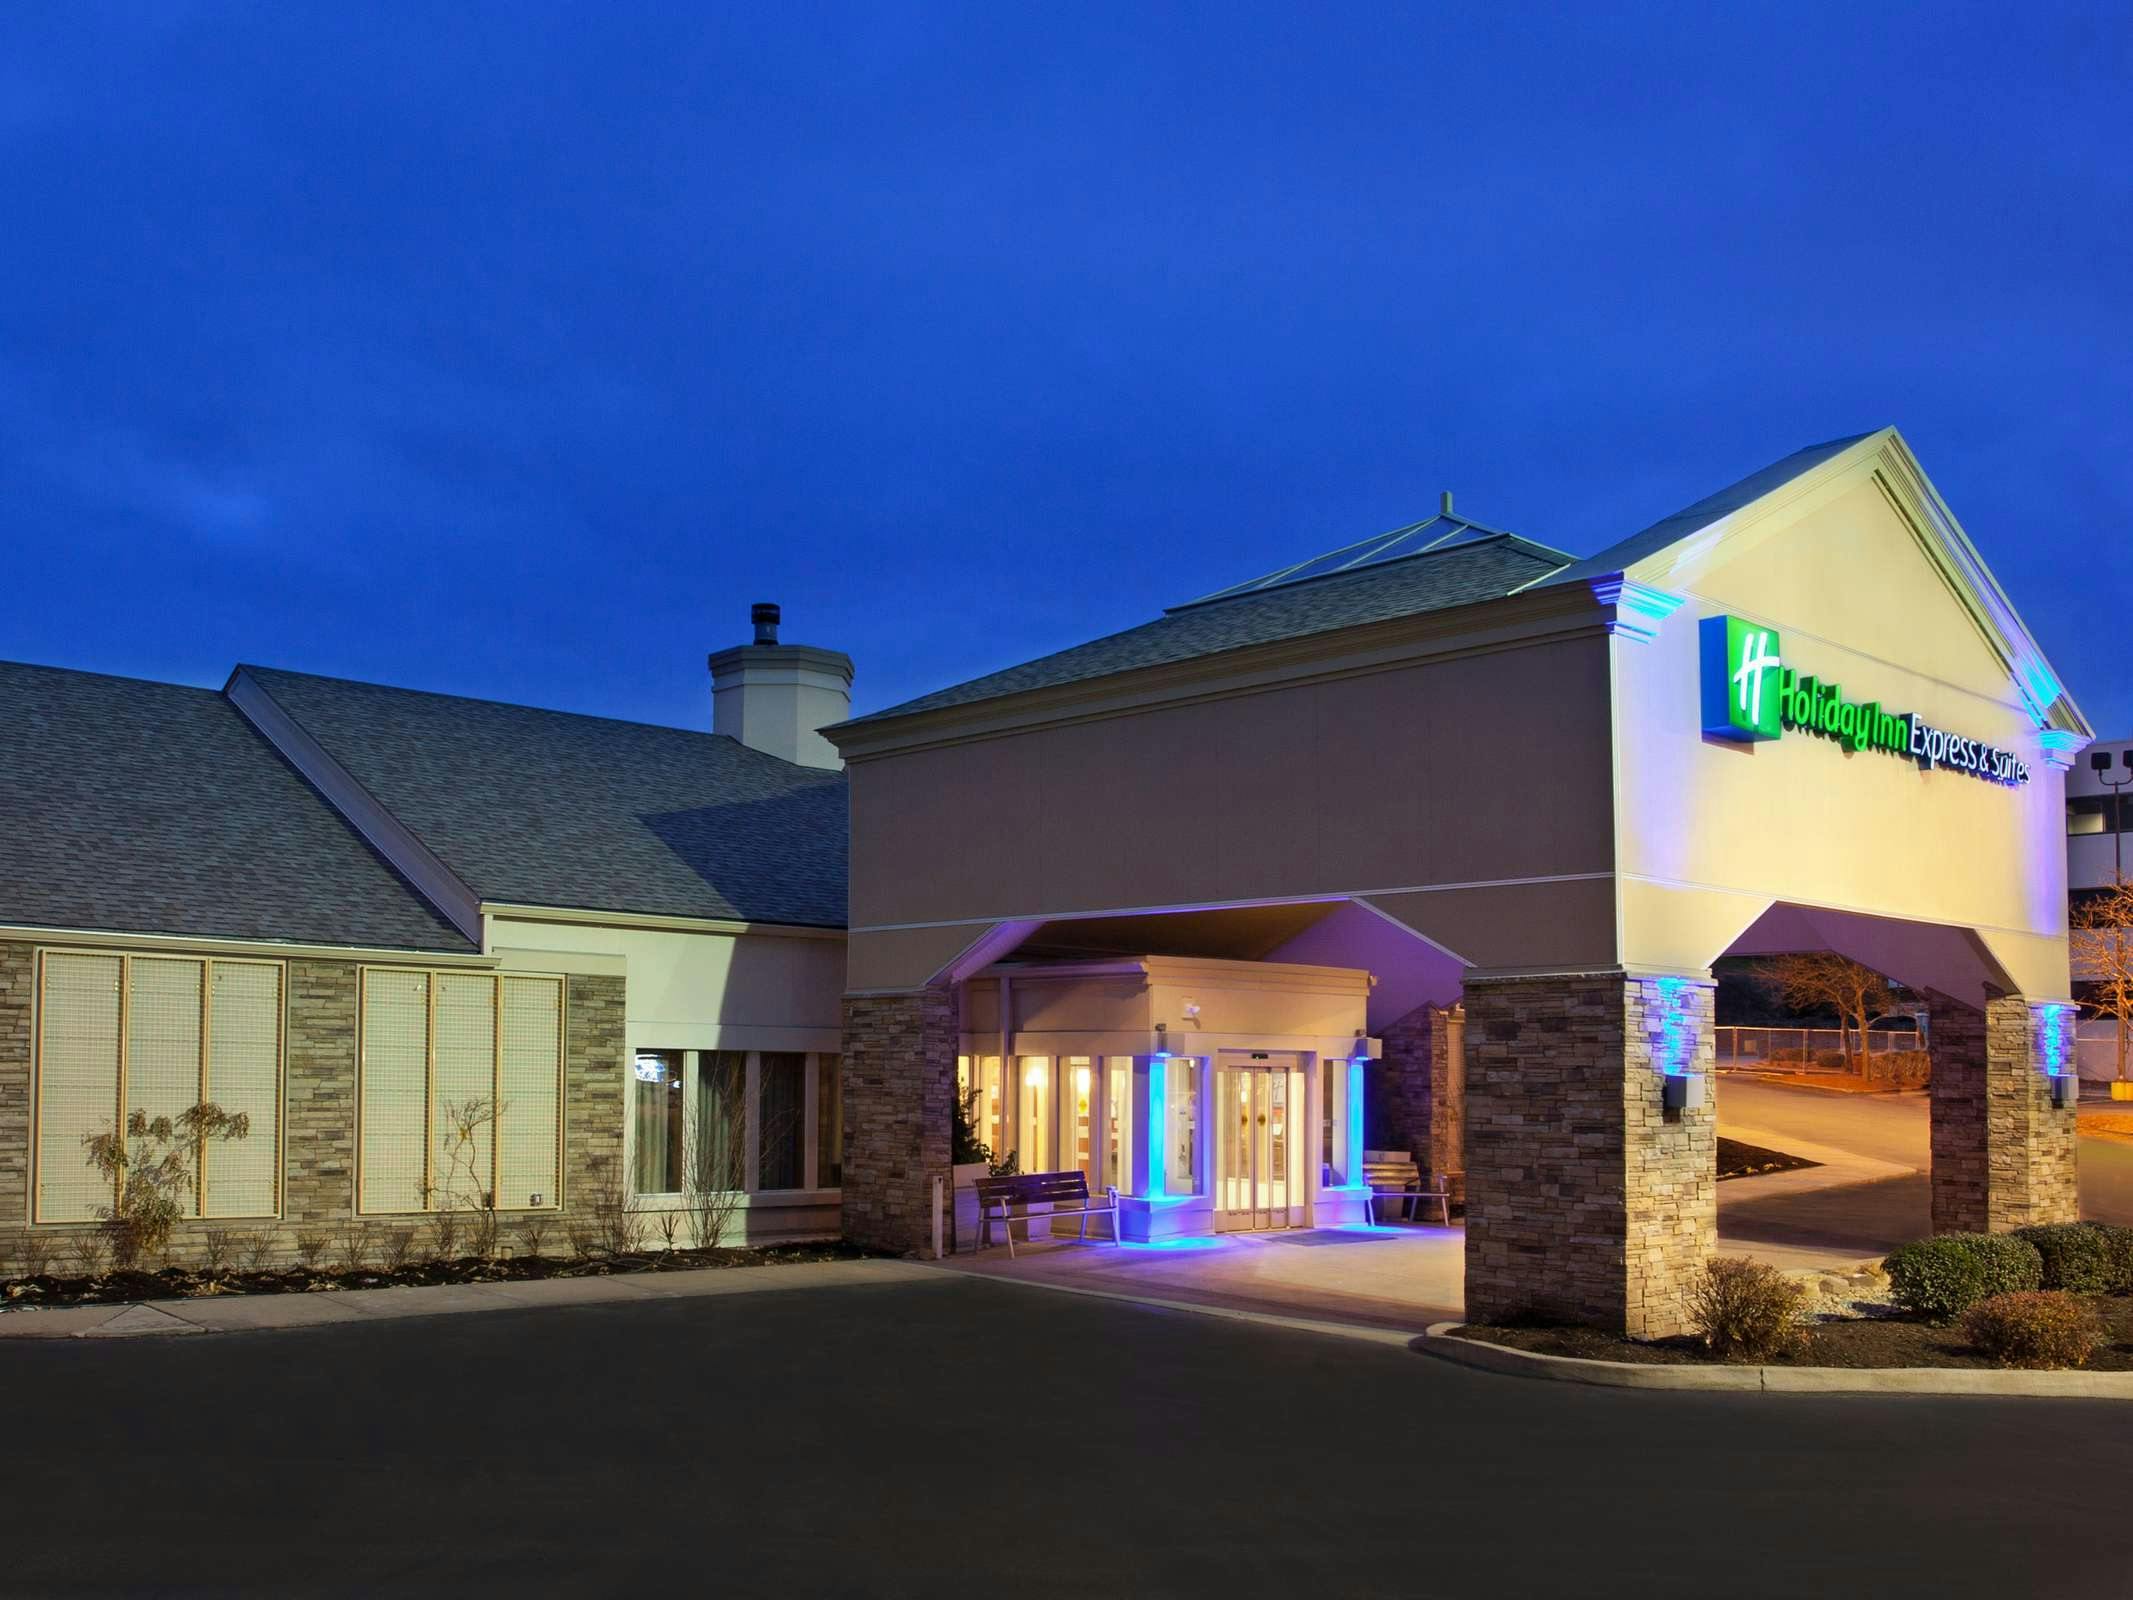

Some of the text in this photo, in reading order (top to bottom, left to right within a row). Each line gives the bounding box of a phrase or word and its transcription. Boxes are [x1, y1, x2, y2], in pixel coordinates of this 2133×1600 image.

[1779, 667, 2032, 785] Holiday Inn Express & Suites
